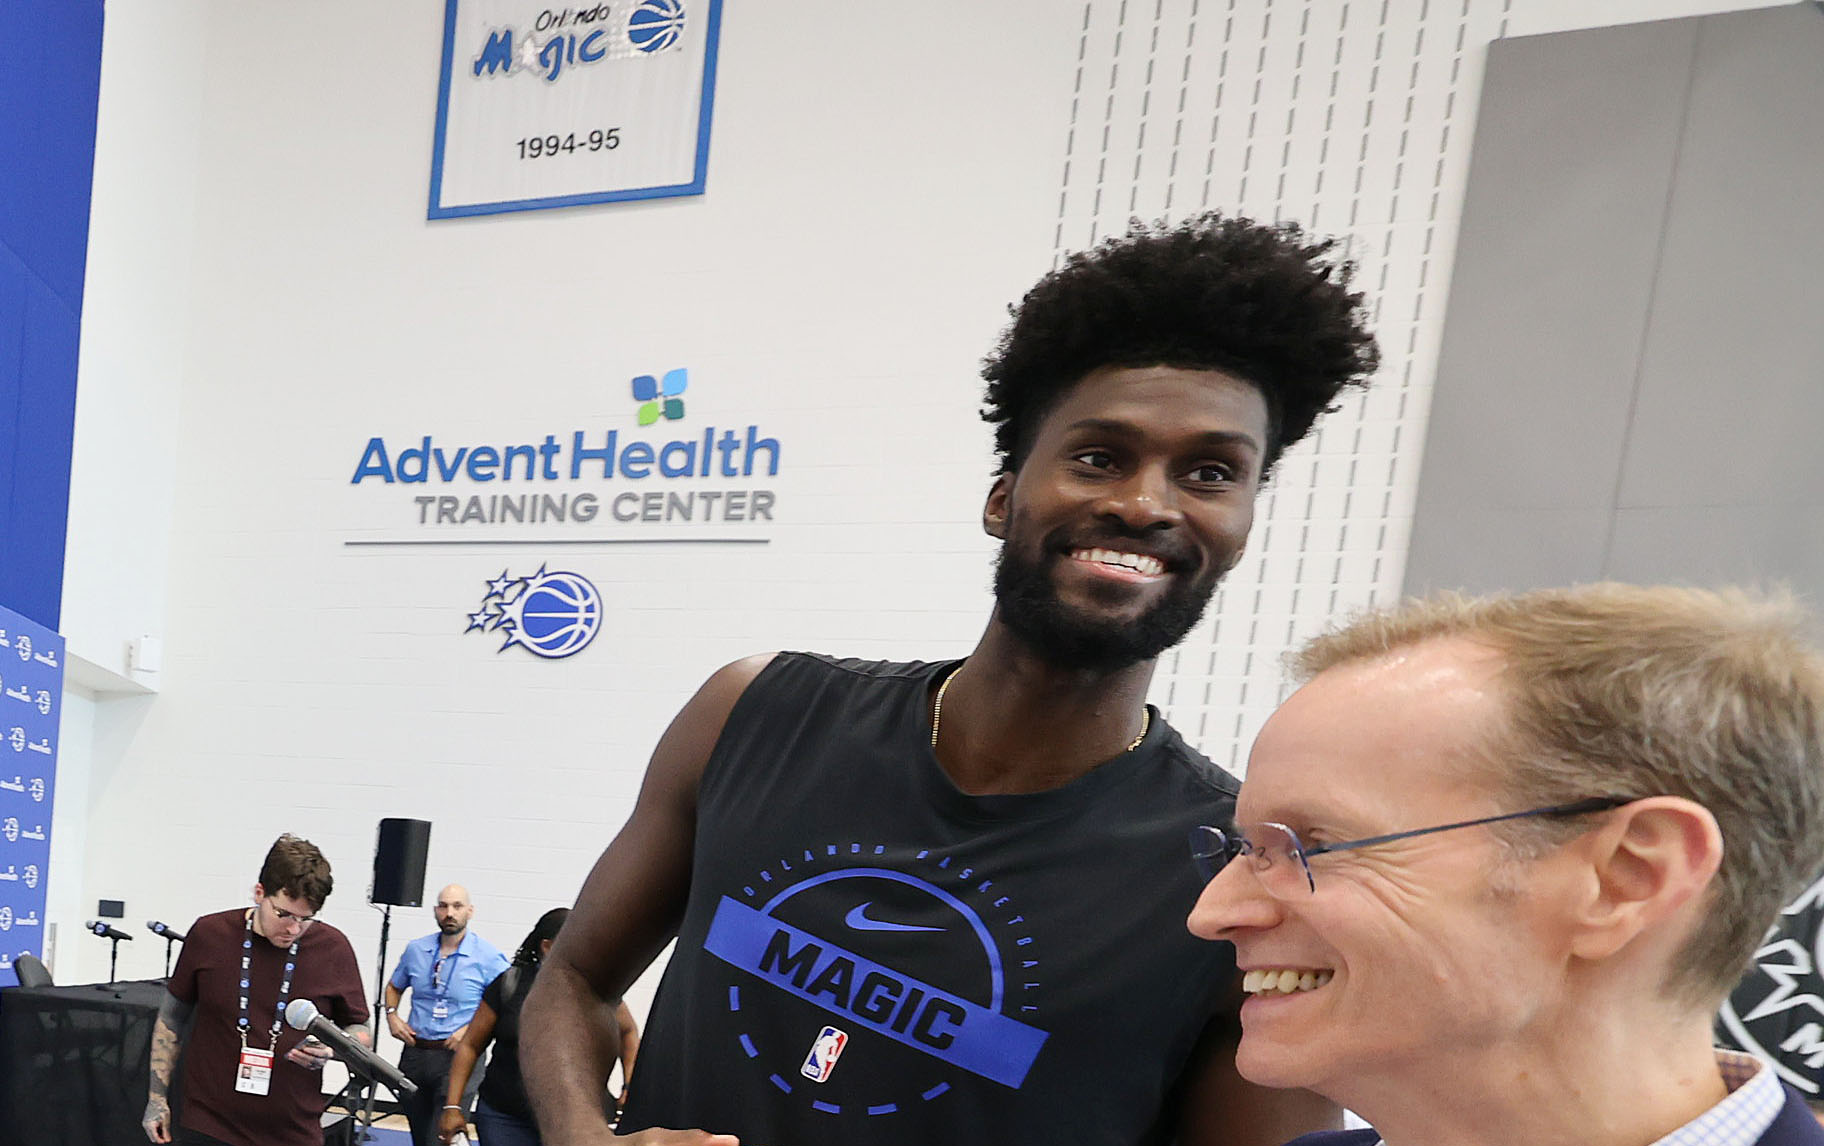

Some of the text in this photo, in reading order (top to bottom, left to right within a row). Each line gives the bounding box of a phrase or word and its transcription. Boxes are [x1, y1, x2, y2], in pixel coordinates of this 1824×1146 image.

[535, 3, 611, 32] Orlndo
[517, 127, 621, 160] 1994-95
[350, 425, 781, 485] AdventHealth
[414, 490, 777, 525] TRAINING CENTER
[757, 928, 967, 1051] MAGIC
